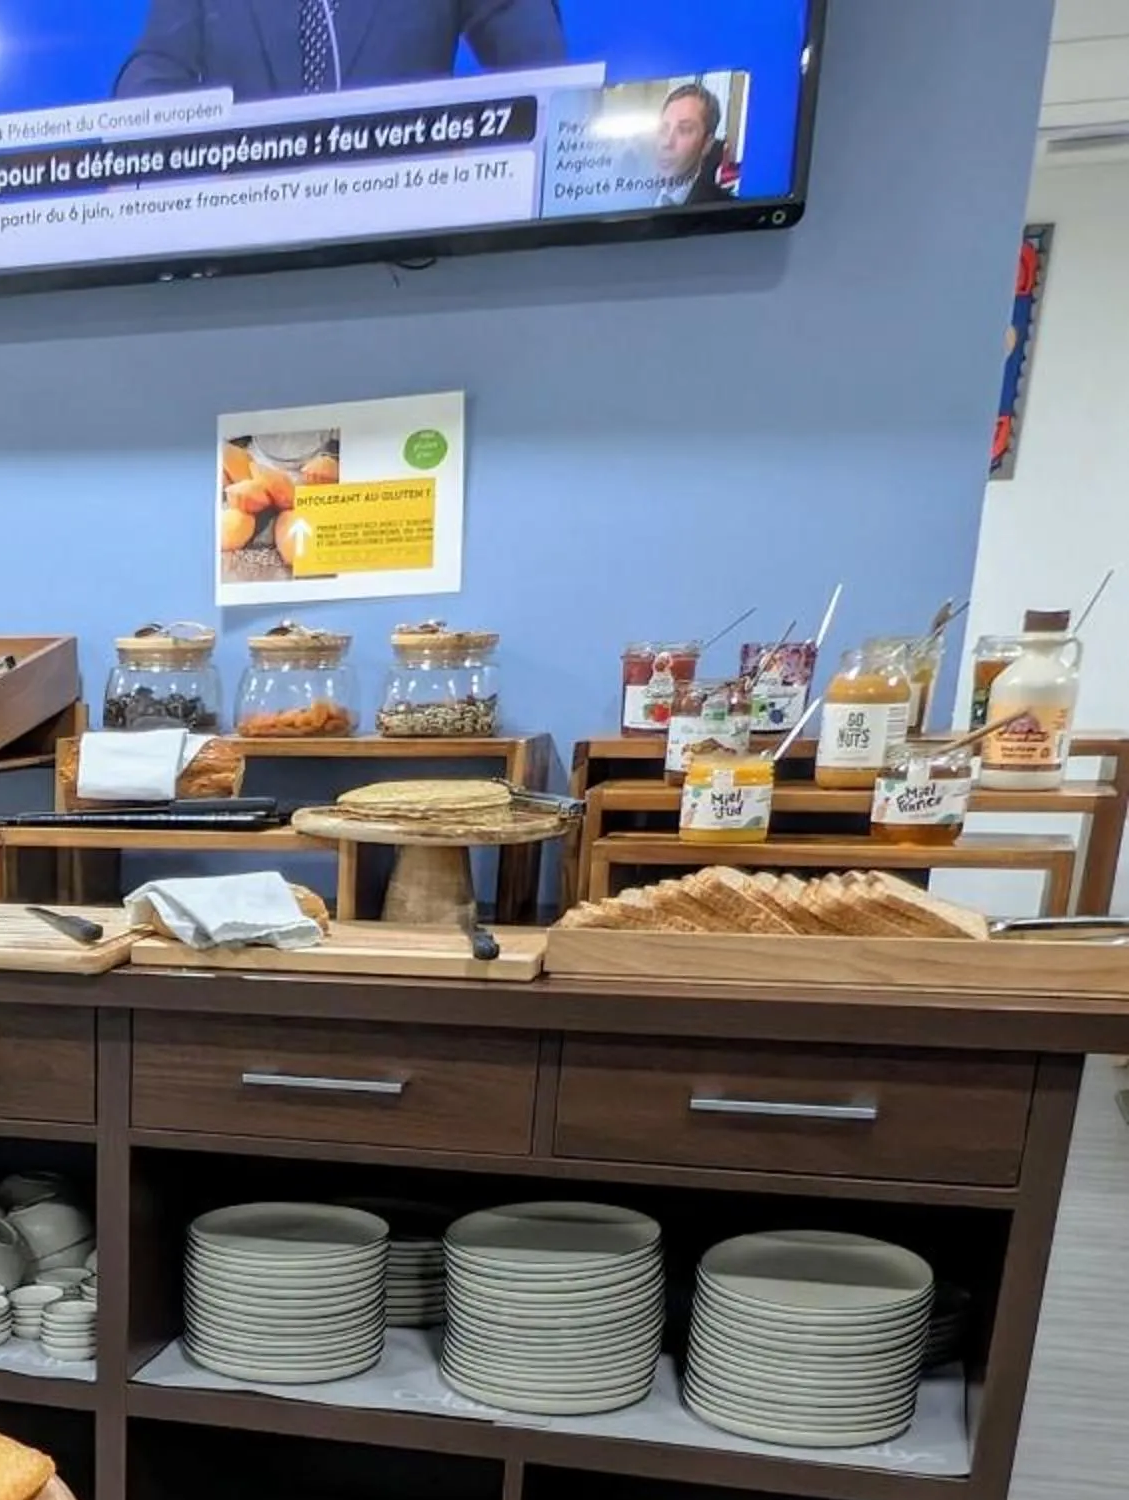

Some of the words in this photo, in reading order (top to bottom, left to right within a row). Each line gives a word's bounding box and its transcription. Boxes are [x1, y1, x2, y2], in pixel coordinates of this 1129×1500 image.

[7, 119, 71, 140] Président
[76, 116, 94, 132] du
[97, 108, 150, 129] Conseil
[154, 104, 224, 124] européen
[50, 156, 71, 182] la
[76, 151, 164, 180] défense
[169, 135, 308, 171] européenne
[327, 124, 369, 152] feu
[374, 118, 426, 148] vert
[431, 112, 474, 142] des
[479, 105, 512, 136] 27
[0, 208, 42, 233] partir
[46, 206, 64, 223] du
[68, 204, 79, 222] 6
[81, 203, 114, 224] juin,
[119, 196, 192, 216] retrouvez
[196, 182, 300, 208] franceinfoTV
[305, 184, 329, 199] sur
[334, 178, 348, 195] le
[352, 171, 399, 193] canal
[404, 168, 423, 188] 16
[428, 168, 448, 185] de
[454, 165, 470, 182] la
[474, 160, 514, 181] TNT.
[554, 180, 611, 200] Député
[847, 712, 865, 727] GO
[837, 728, 871, 749] NUTS
[711, 788, 742, 806] Miel
